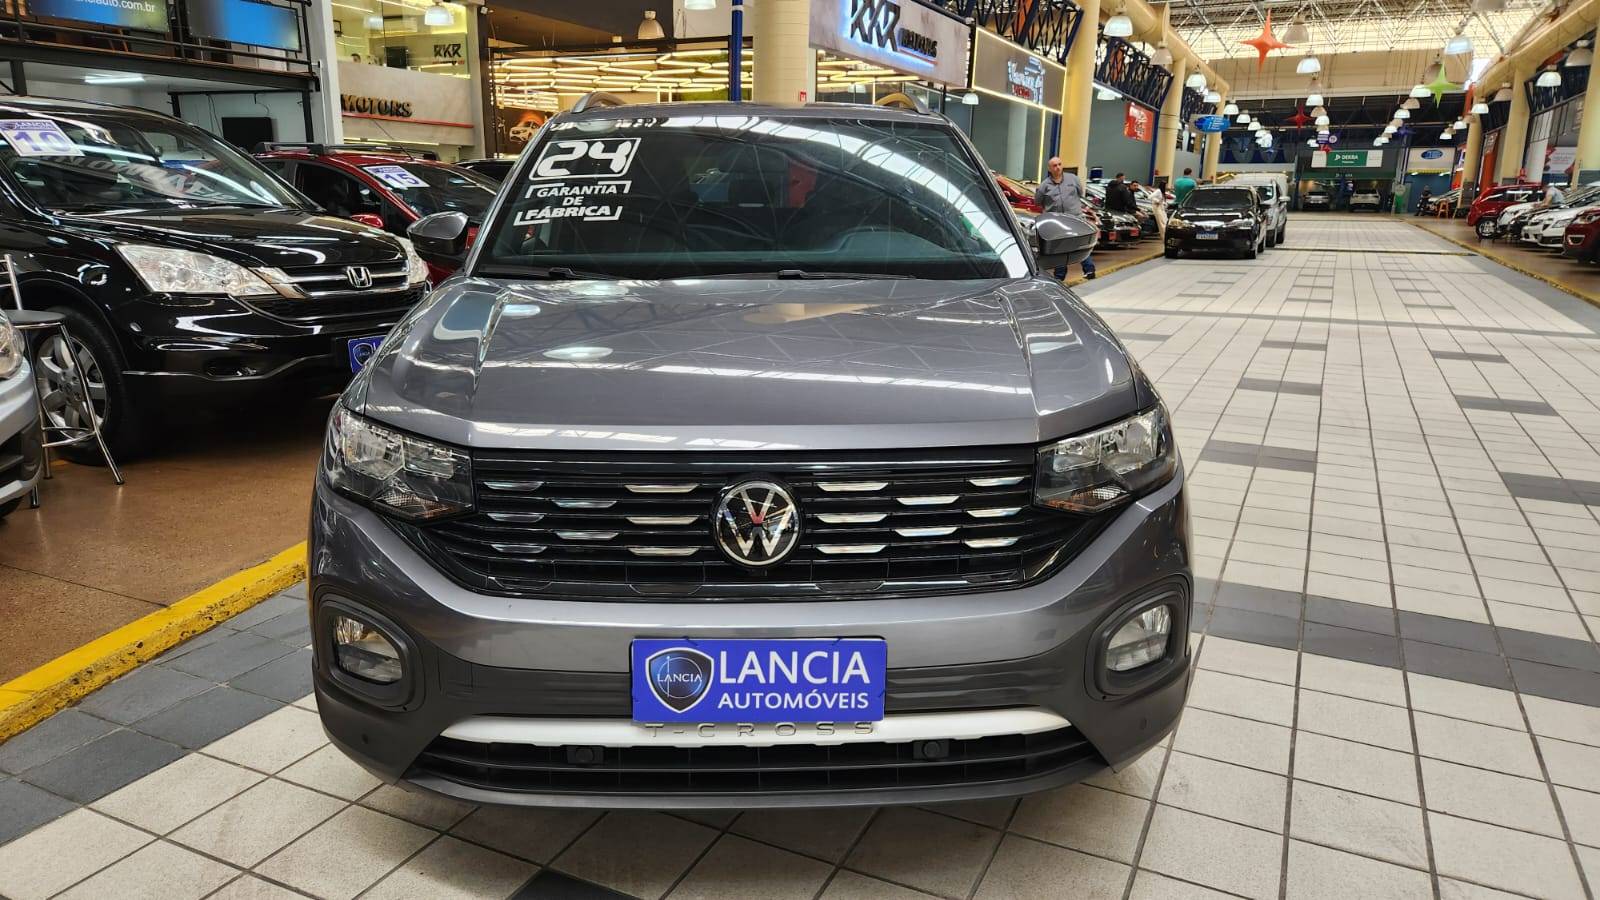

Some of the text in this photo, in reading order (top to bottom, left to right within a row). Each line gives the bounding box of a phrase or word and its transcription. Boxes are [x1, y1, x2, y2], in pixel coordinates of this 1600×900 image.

[340, 94, 413, 118] MOTORS
[14, 131, 71, 152] 10
[537, 141, 632, 176] 24
[384, 173, 420, 185] 15
[536, 185, 617, 198] GARANTIA
[562, 196, 584, 206] DE
[525, 205, 611, 220] FÁBRICA
[719, 650, 871, 684] LANCIA
[657, 673, 703, 683] LANCIA
[717, 689, 870, 709] AUTOMÓVEIS
[645, 721, 875, 738] T-CROSS
